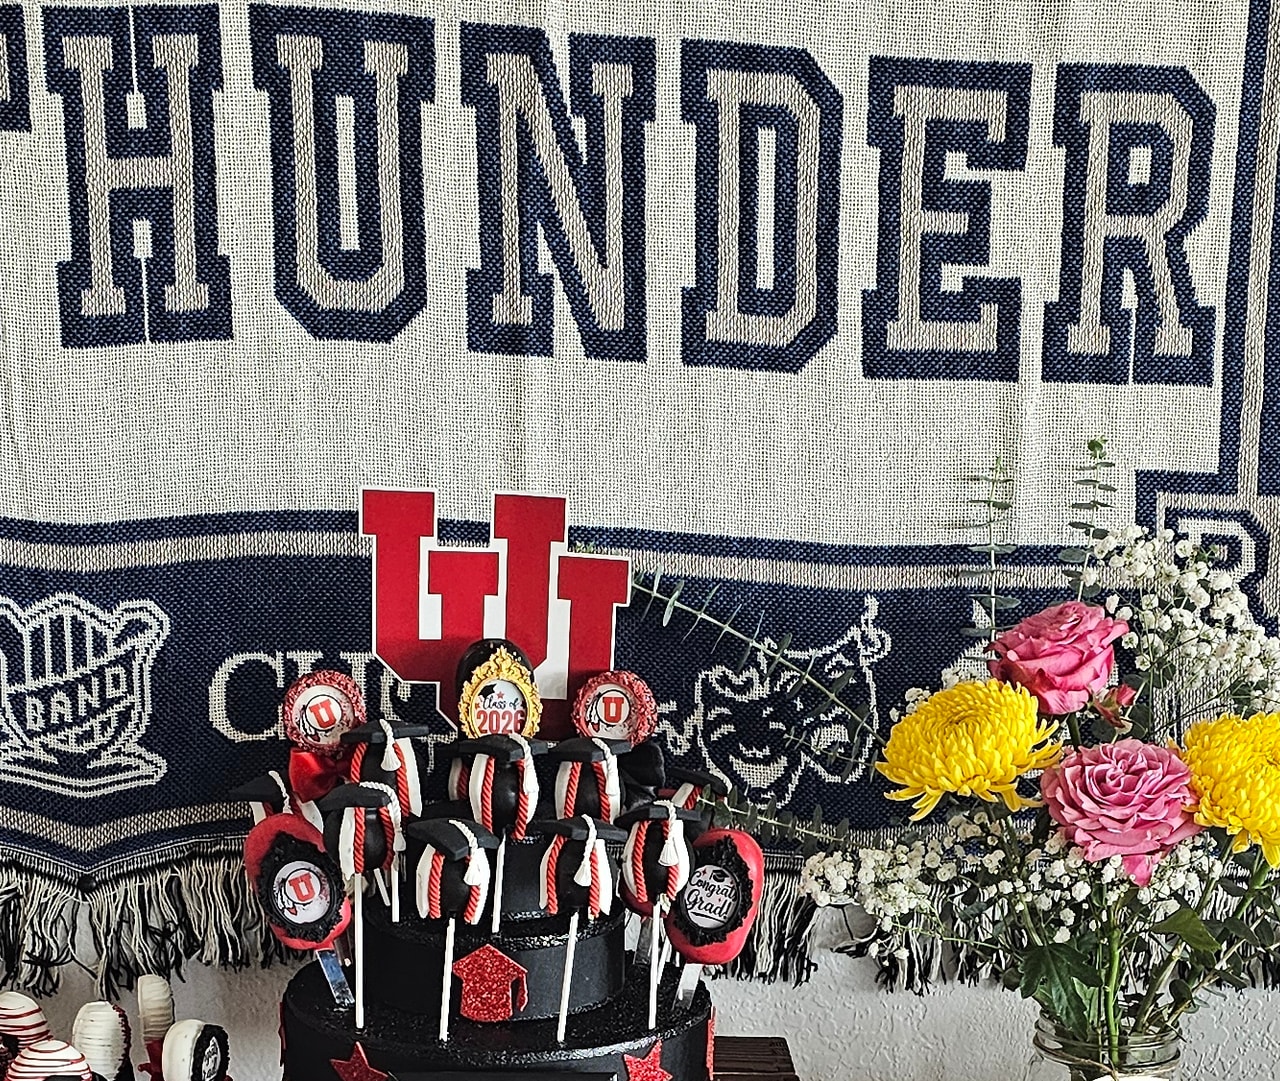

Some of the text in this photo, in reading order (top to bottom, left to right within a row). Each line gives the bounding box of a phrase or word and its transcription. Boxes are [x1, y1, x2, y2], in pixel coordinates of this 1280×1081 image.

[26, 665, 127, 732] BAND
[483, 696, 520, 710] Class of
[476, 709, 526, 734] 2026
